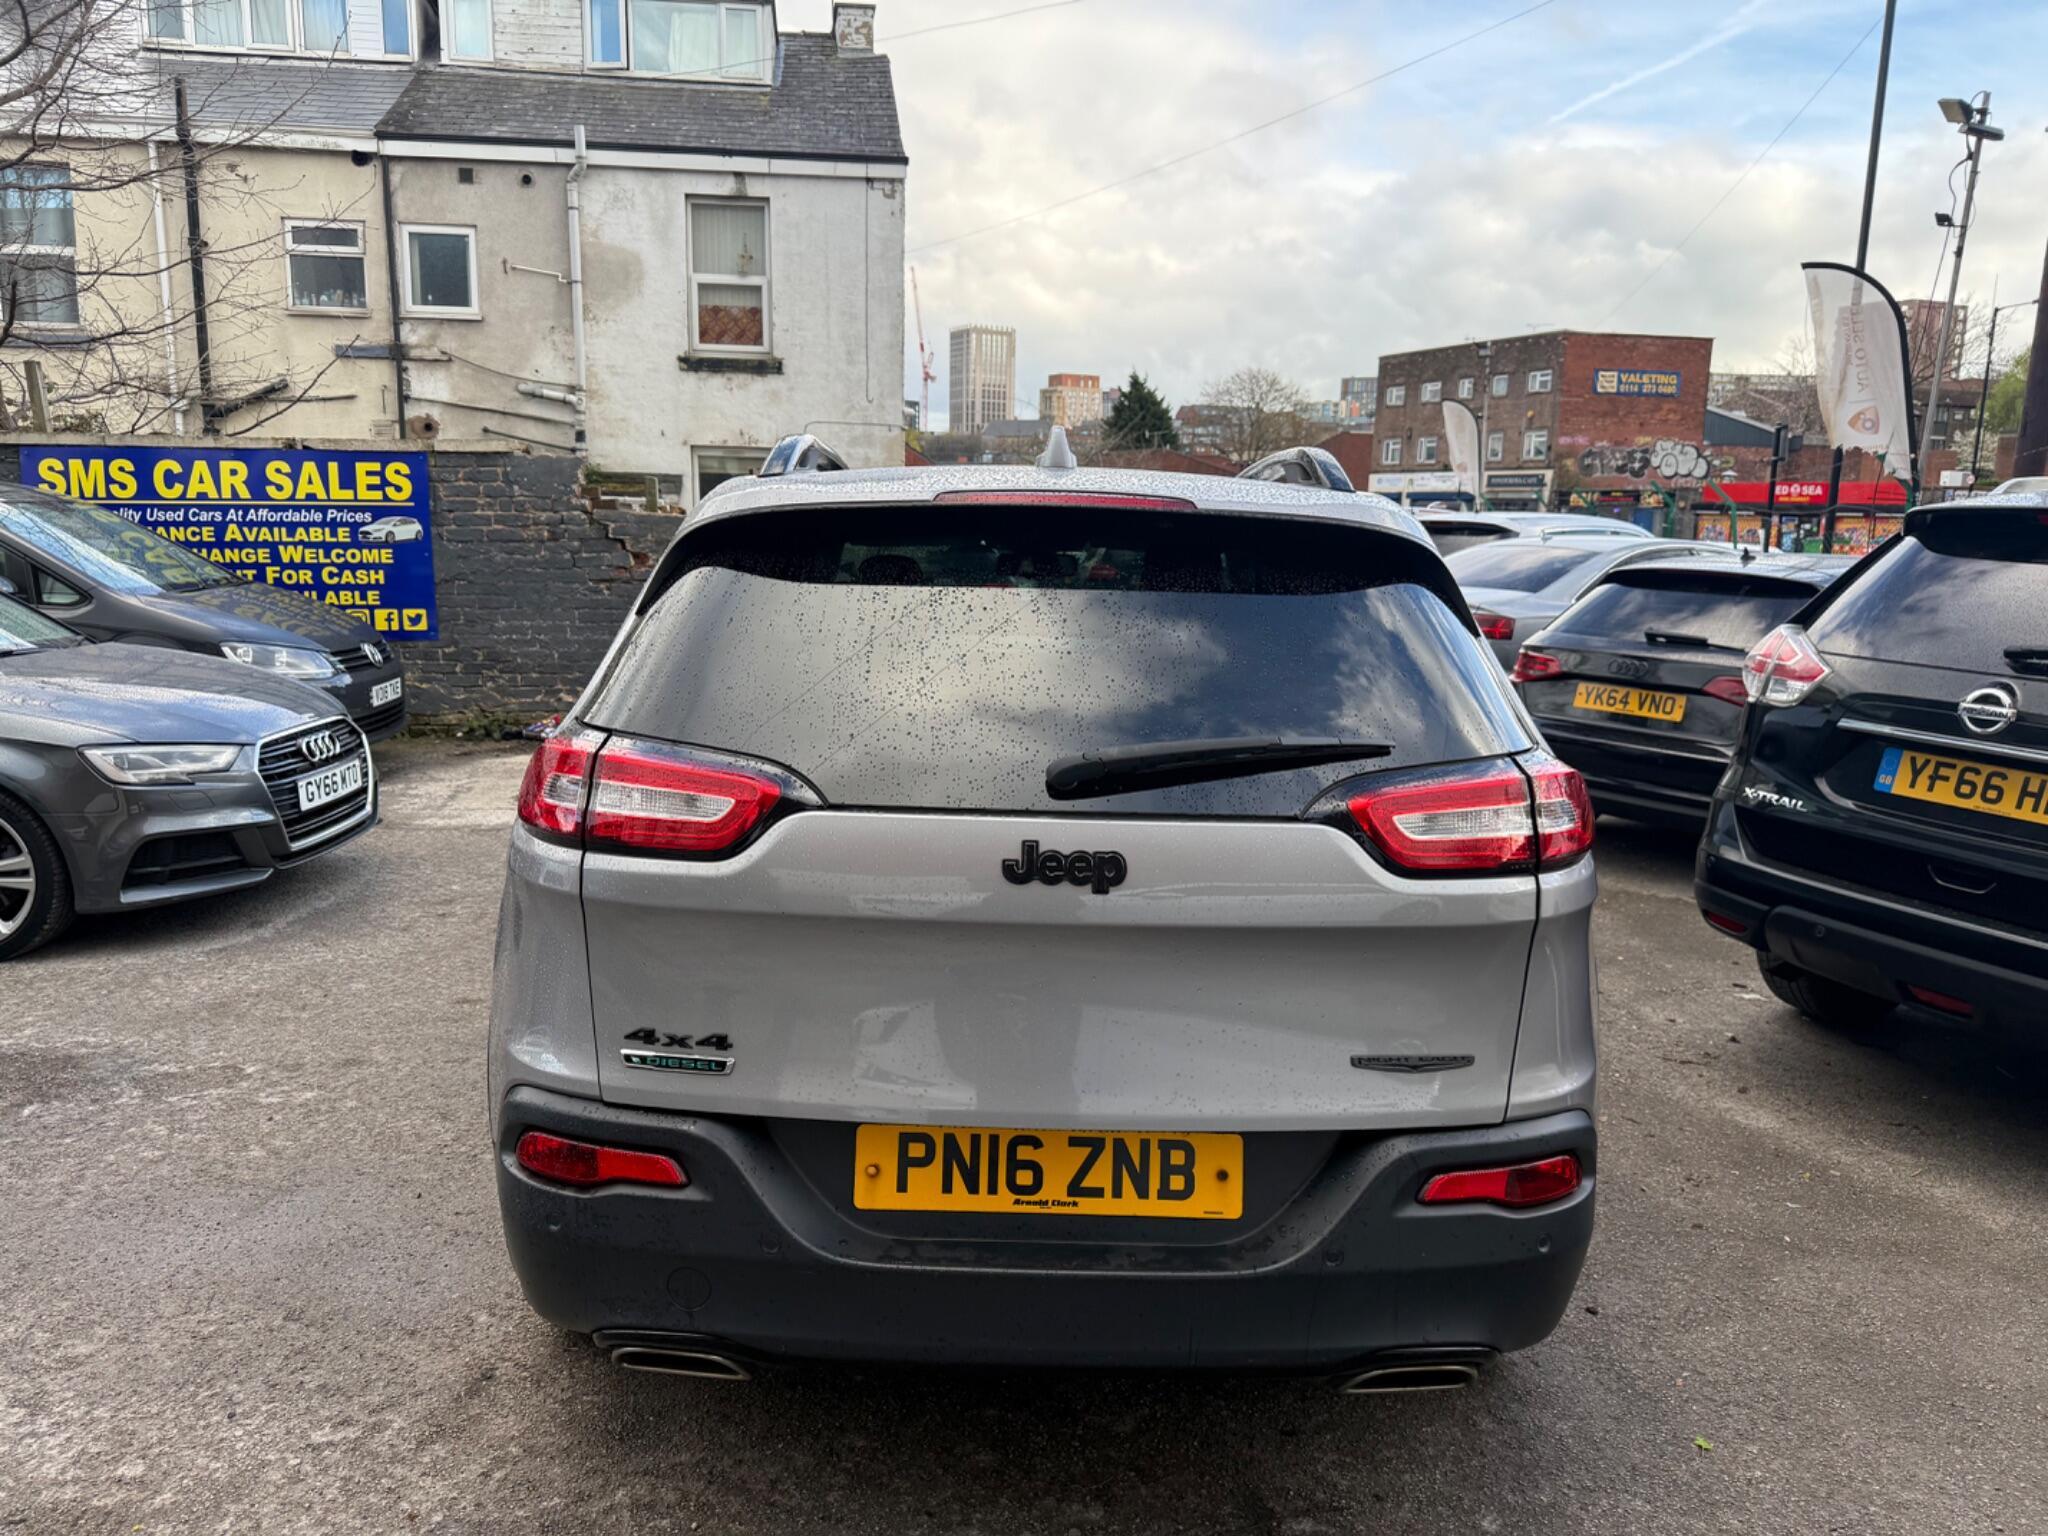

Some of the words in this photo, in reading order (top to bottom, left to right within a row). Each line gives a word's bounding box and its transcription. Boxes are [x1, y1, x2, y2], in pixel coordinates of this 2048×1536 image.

[1619, 372, 1678, 385] VALETING
[37, 458, 138, 499] SMS
[153, 459, 251, 501] CAR
[265, 461, 413, 502] SALES
[1775, 484, 1789, 496] ED
[1801, 484, 1823, 496] SEA
[113, 507, 142, 524] lity
[146, 507, 185, 522] Used
[188, 508, 223, 522] Cars
[226, 509, 244, 522] At
[245, 509, 323, 523] Affordable
[326, 509, 373, 524] Prices
[149, 526, 216, 542] ANCE
[224, 523, 351, 543] AVAILABLE
[192, 547, 272, 564] HANGE
[278, 545, 394, 564] WELCOME
[266, 566, 315, 585] FOR
[321, 566, 386, 585] CASH
[1584, 685, 1631, 709] YK64
[1637, 692, 1677, 715] VNO
[305, 772, 339, 803] GY66
[1908, 756, 2008, 805] YF66
[2015, 776, 2048, 815] H
[1742, 786, 1809, 813] X-TRAIL
[1002, 839, 1128, 895] Jeep
[645, 1056, 723, 1071] DIESEL
[895, 1131, 1044, 1197] PN16
[1066, 1136, 1196, 1201] ZNB
